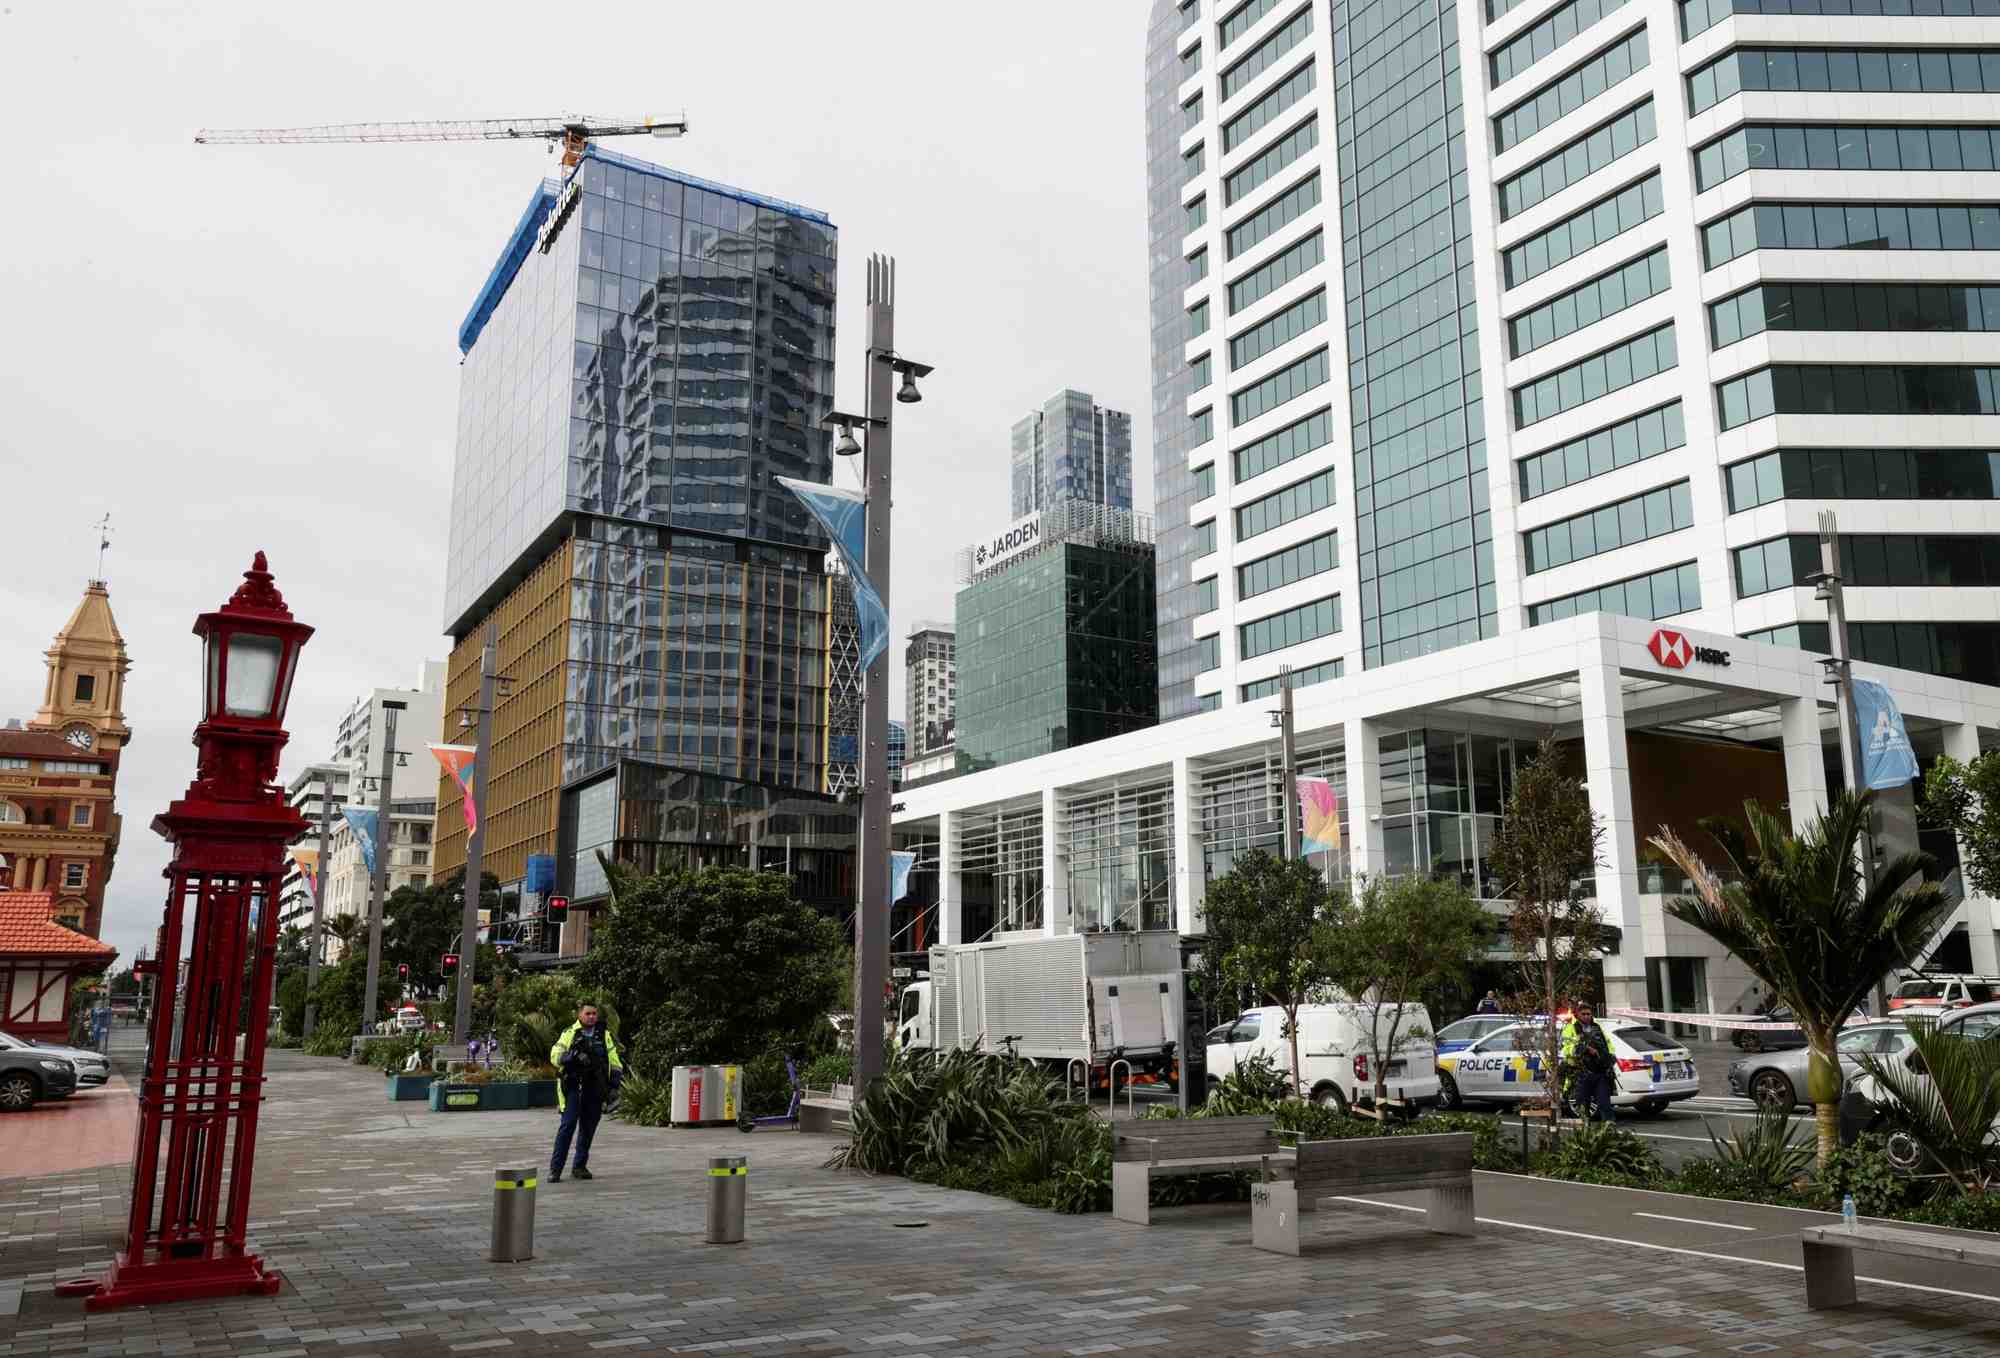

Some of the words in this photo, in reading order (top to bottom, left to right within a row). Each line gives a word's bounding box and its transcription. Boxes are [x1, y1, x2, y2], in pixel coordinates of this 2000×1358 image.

[989, 519, 1039, 559] JARDEN
[1694, 645, 1731, 667] HSBC
[1459, 1059, 1503, 1071] POLICE
[1663, 1070, 1688, 1081] POLICE
